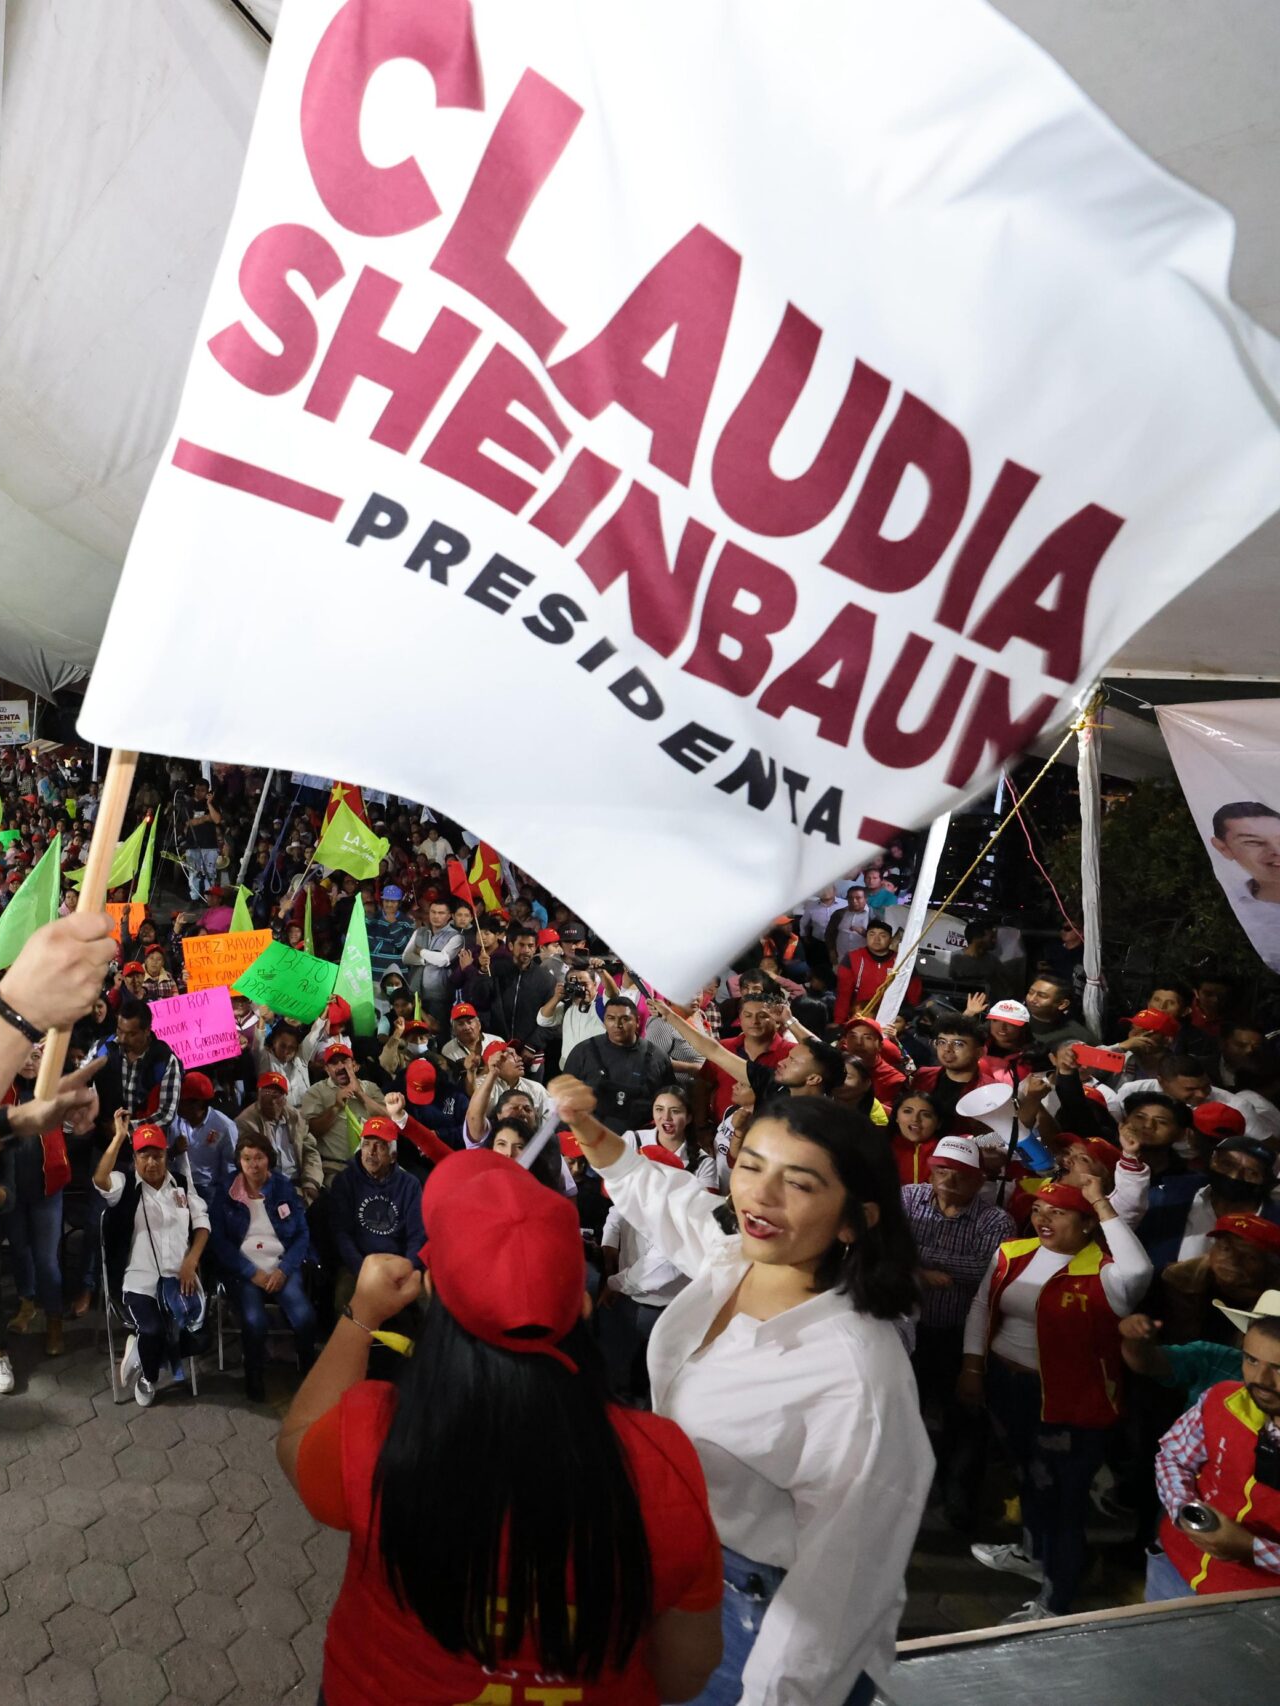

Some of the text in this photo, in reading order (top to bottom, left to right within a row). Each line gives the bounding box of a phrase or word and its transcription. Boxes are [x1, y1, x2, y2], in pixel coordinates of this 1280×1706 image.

[300, 0, 1125, 685] CLAUDIA
[345, 492, 842, 846] PRESIDENTA
[227, 936, 265, 951] RAYON
[276, 947, 331, 984] BETO
[186, 991, 210, 1009] ROA
[941, 1143, 973, 1154] ARMENTA
[1061, 1292, 1089, 1313] PT
